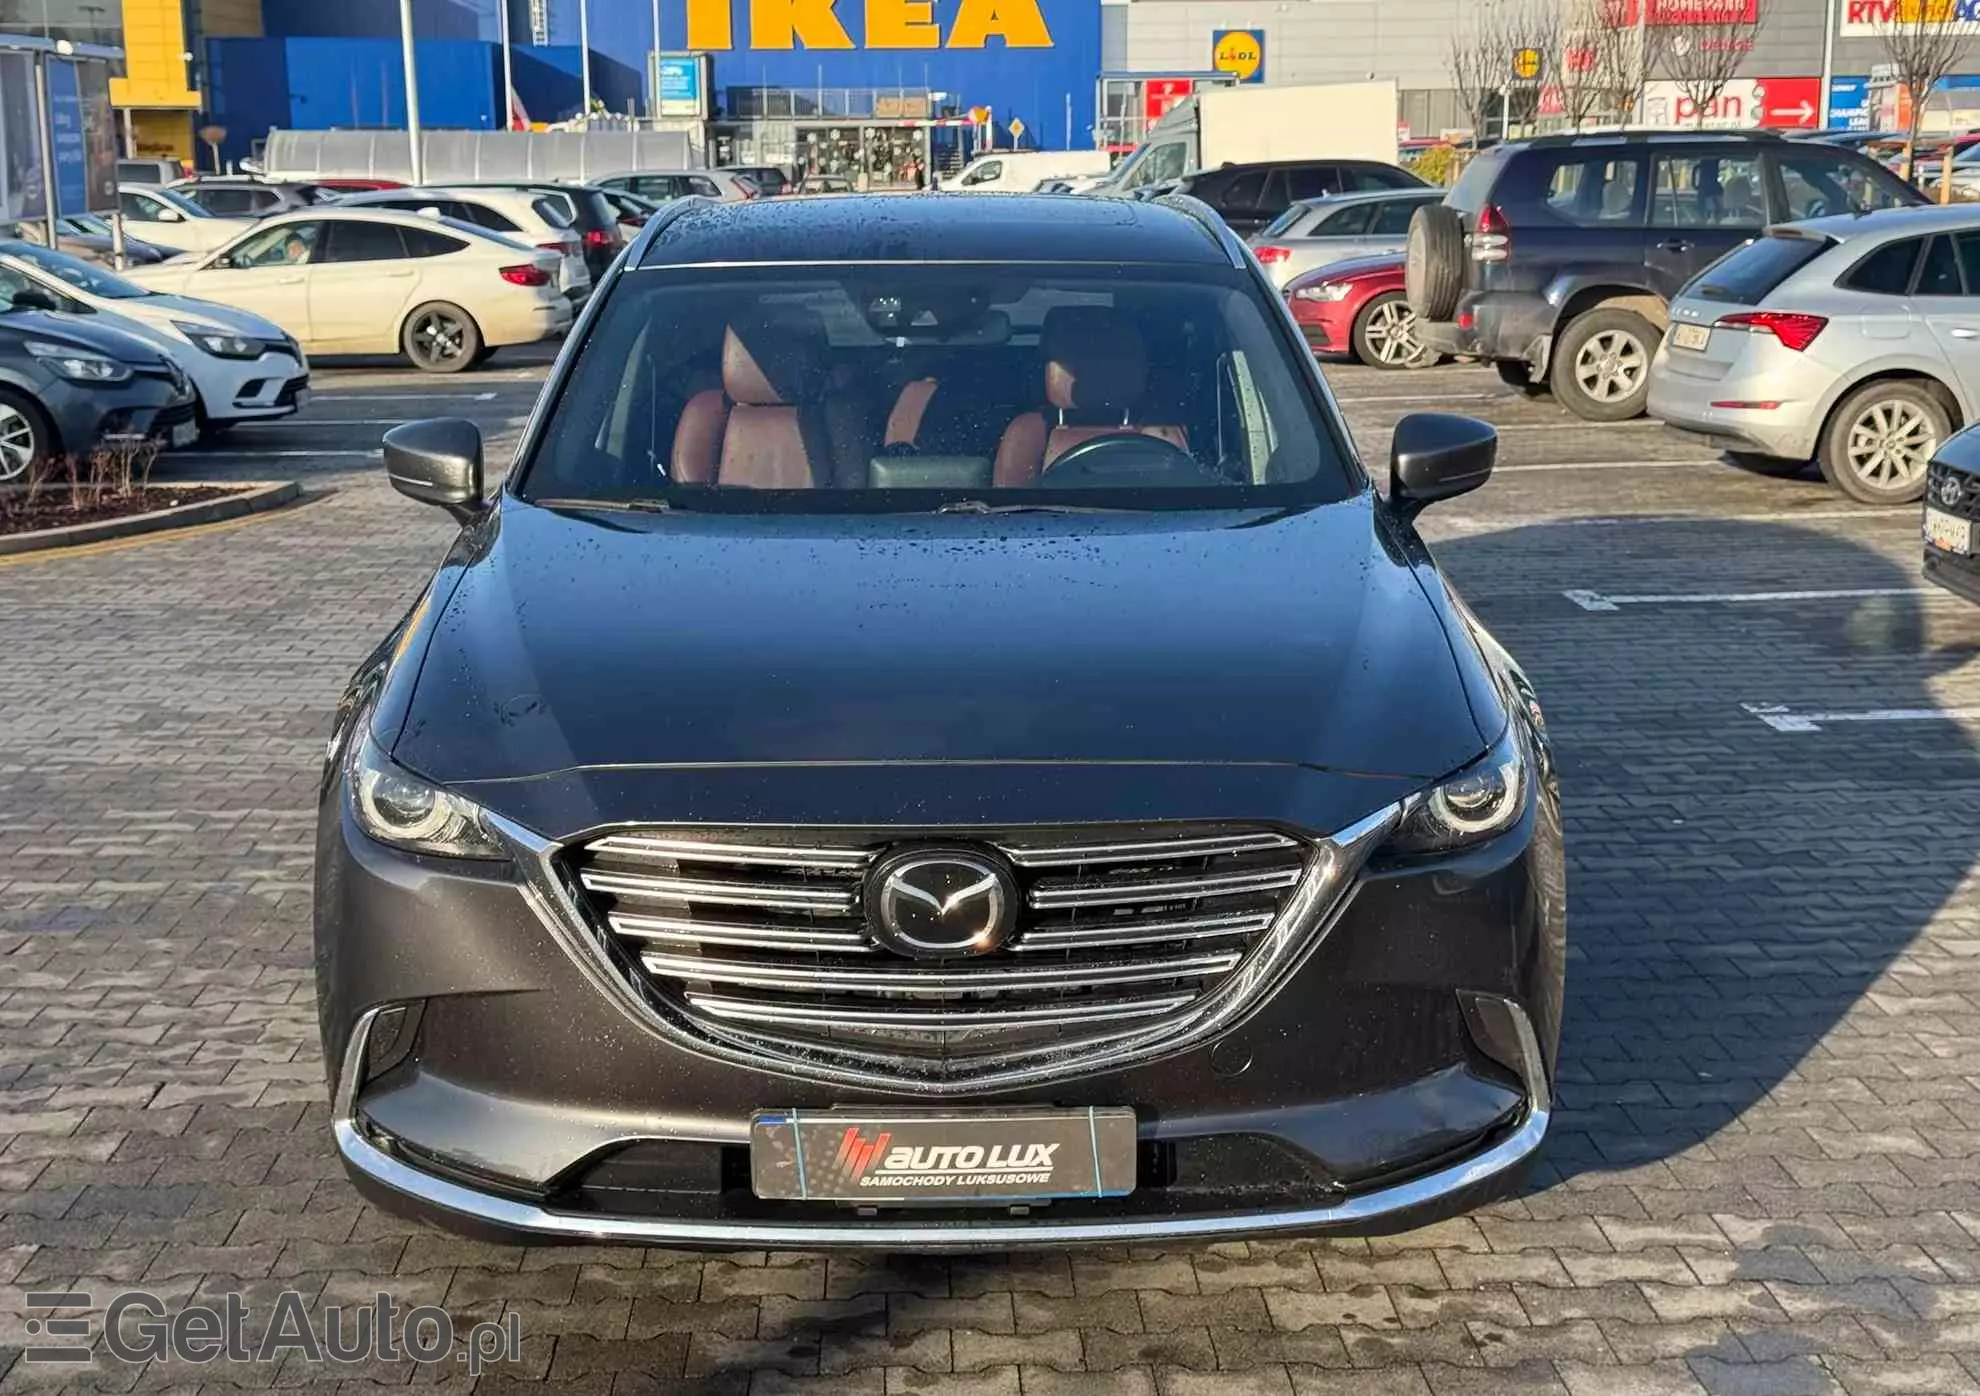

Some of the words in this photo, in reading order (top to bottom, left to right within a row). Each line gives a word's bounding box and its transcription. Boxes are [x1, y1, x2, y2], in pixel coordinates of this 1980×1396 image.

[1848, 0, 1895, 23] RTV
[687, 0, 1053, 49] IKEA
[1675, 95, 1742, 125] pan
[986, 1143, 1060, 1168] LUX
[860, 1175, 953, 1187] SAMOCHODY
[956, 1173, 1050, 1185] LUKSUSOWE
